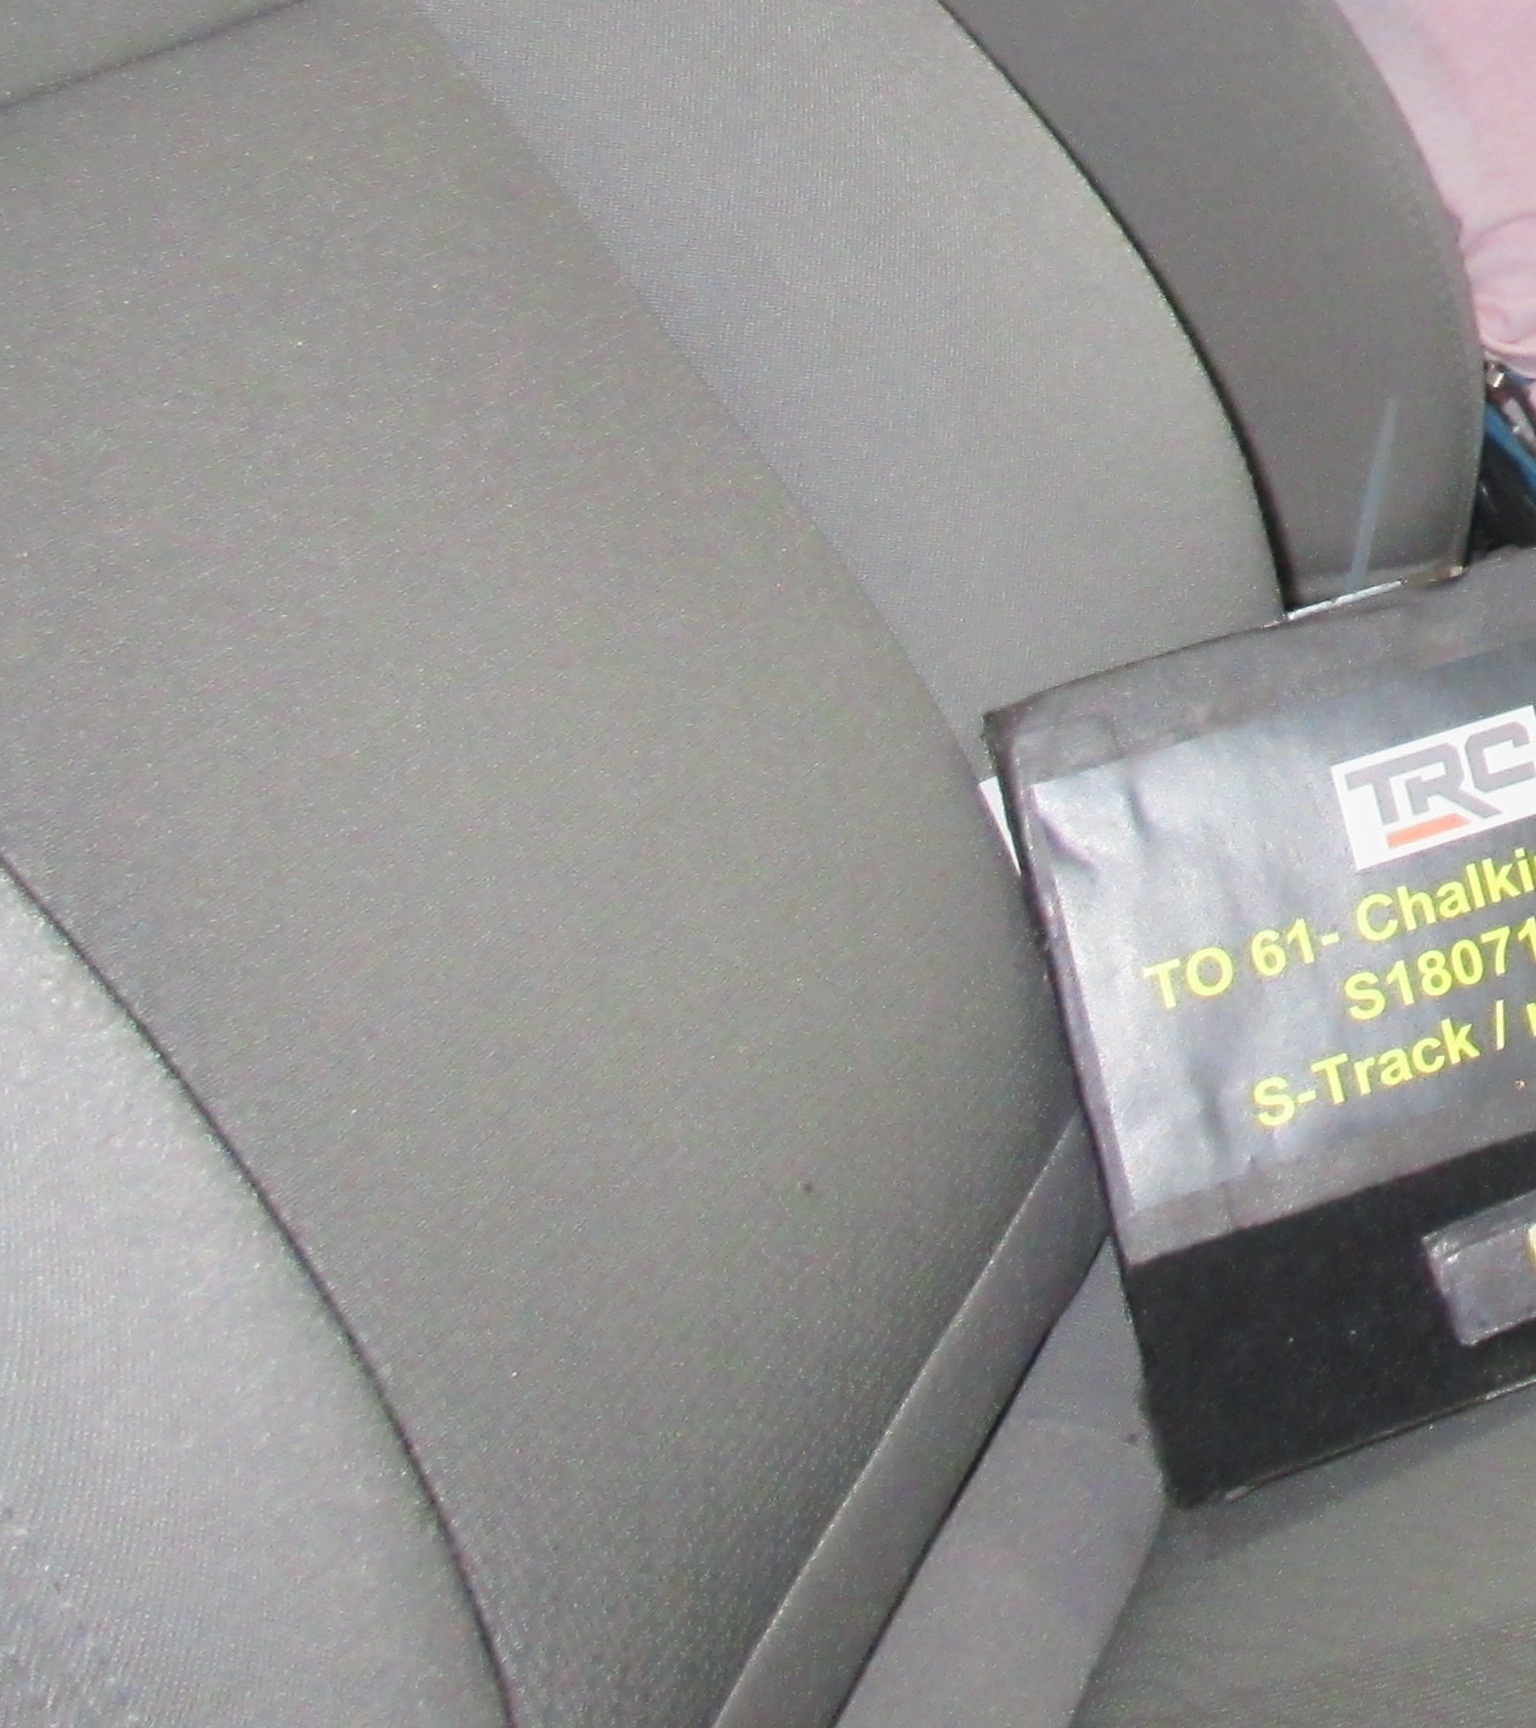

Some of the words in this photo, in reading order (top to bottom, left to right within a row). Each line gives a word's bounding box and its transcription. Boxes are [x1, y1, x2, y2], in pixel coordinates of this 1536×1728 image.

[1145, 947, 1234, 1009] TO
[1251, 917, 1339, 978] 61-
[1252, 1016, 1479, 1128] S-Track
[1494, 1000, 1509, 1052] /
